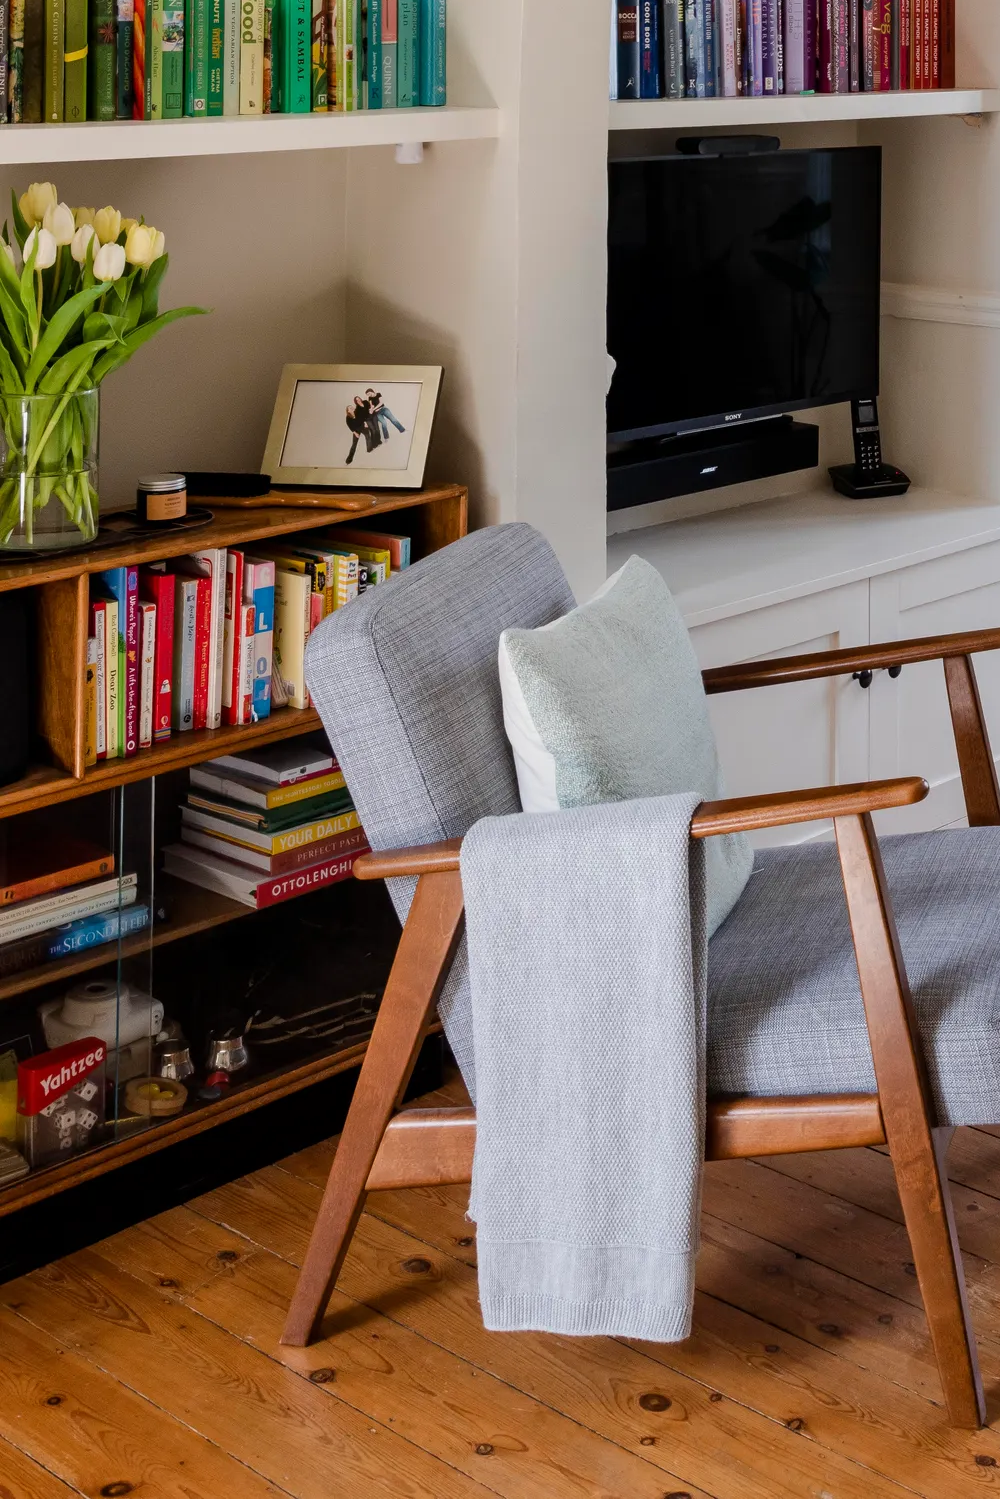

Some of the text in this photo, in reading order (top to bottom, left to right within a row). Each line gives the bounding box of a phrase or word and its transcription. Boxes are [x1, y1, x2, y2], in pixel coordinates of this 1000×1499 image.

[401, 3, 409, 27] plan
[382, 56, 392, 95] QUINN
[724, 413, 742, 421] SONY
[128, 620, 137, 645] Peppa?
[200, 663, 208, 688] Santa
[285, 784, 322, 799] MONTESSORI
[279, 815, 352, 850] YOUR DAILY
[297, 844, 337, 862] PERFECT
[272, 860, 352, 896] OTTOLENGHI
[63, 924, 115, 952] SECOND
[40, 1047, 104, 1096] Yahtzee
